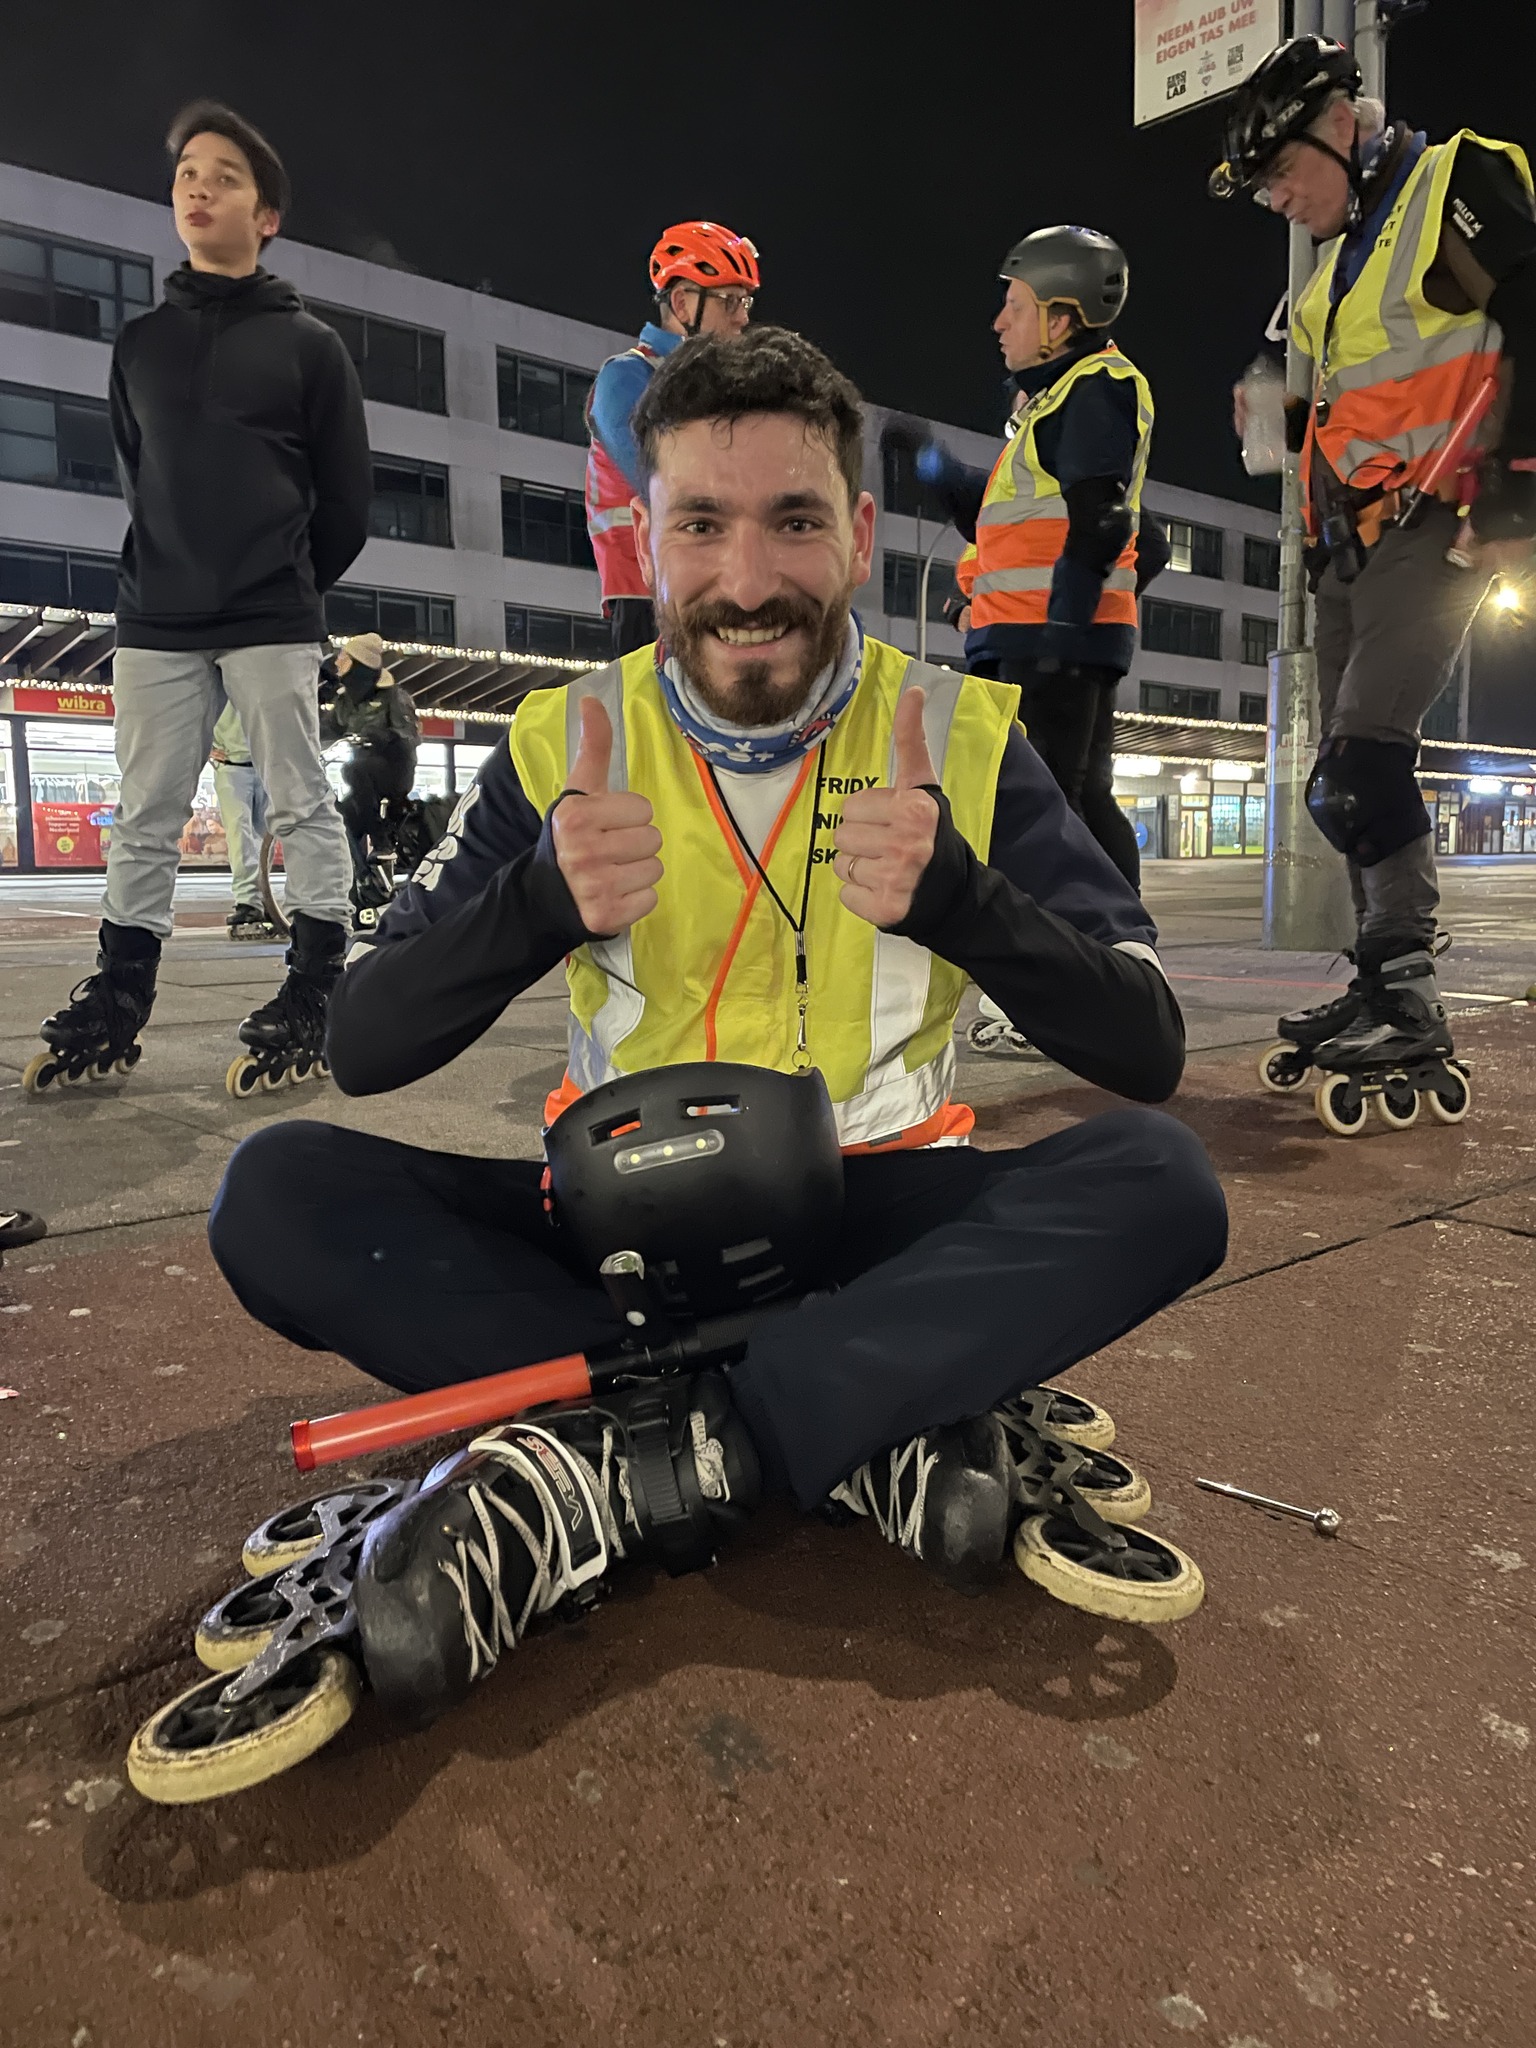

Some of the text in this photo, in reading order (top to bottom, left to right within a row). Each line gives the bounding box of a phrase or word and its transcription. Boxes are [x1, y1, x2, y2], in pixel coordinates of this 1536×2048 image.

[1156, 11, 1257, 64] EIGEN TAS MEE
[1157, 0, 1255, 47] NEEM AUB UW
[1167, 84, 1186, 100] LAB
[57, 695, 106, 712] wibra
